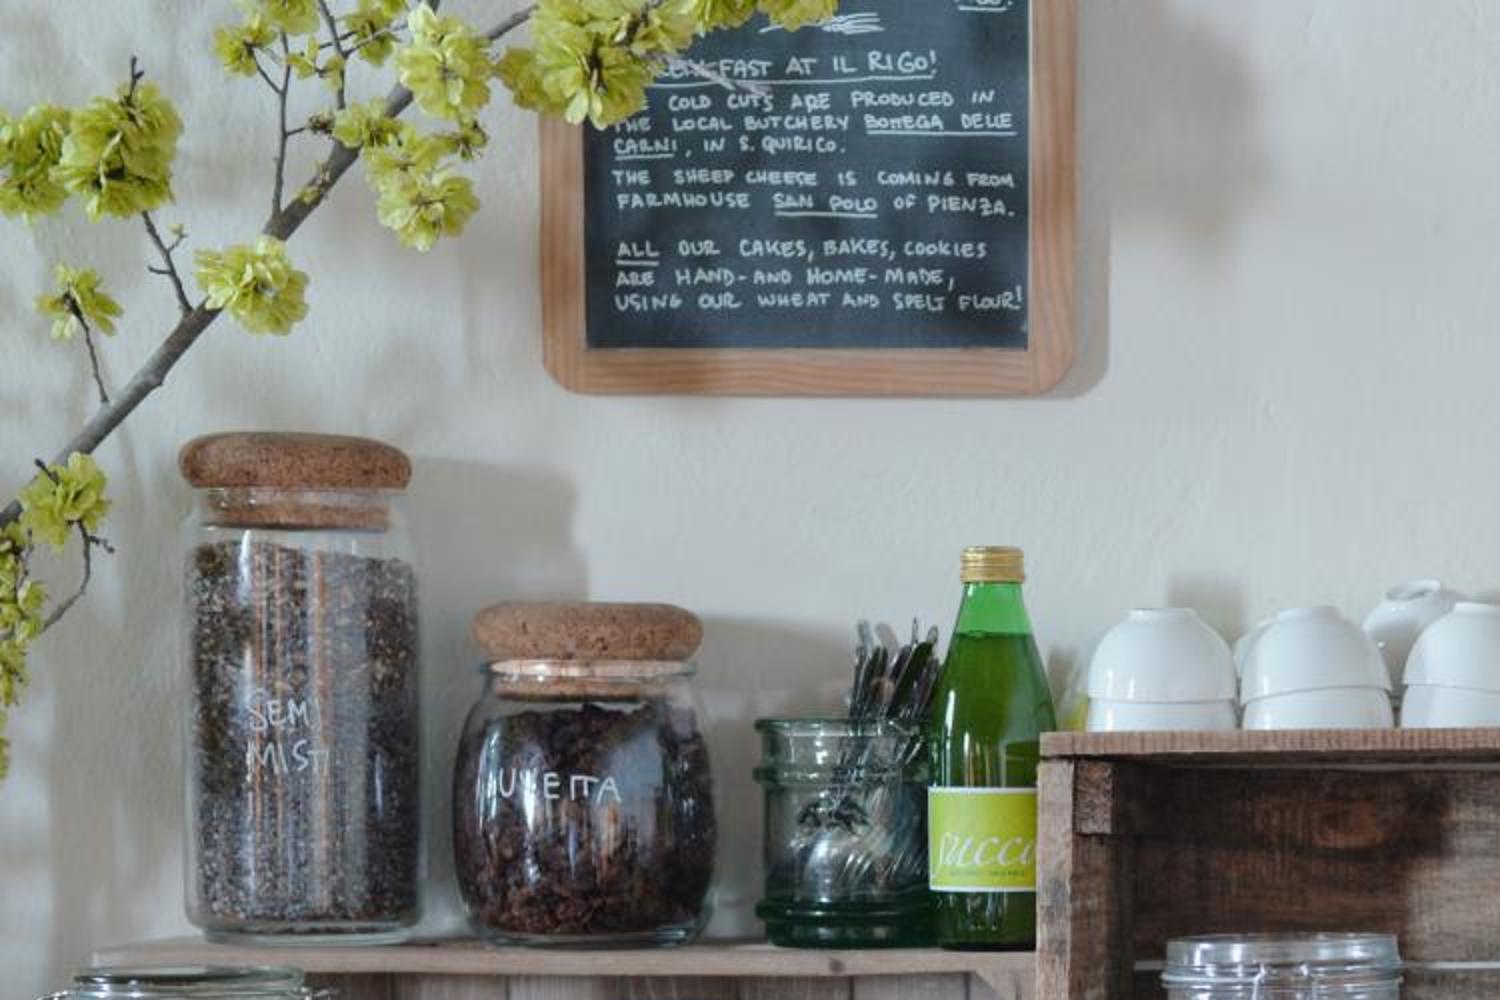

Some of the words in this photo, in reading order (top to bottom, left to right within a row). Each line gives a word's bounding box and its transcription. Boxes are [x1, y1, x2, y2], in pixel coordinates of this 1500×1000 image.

[785, 57, 816, 75] AT
[833, 56, 857, 73] IL
[668, 96, 711, 110] COLD
[727, 95, 773, 111] CUTS
[790, 94, 831, 112] ARE
[851, 91, 954, 108] PRODUCED
[972, 90, 995, 103] IN
[672, 118, 733, 131] LOCAL
[744, 116, 849, 131] BUTCHERY
[864, 114, 944, 130] BOTTEGA
[961, 113, 1012, 129] DELLE
[704, 138, 725, 151] IN
[612, 170, 651, 185] THE
[673, 169, 735, 184] SHEEP
[838, 171, 857, 186] IS
[877, 171, 954, 186] COMING
[967, 173, 1015, 187] FROM
[617, 193, 751, 209] FARMHOUSE
[772, 192, 814, 208] SAN
[829, 195, 878, 212] POLO
[893, 194, 917, 208] OF
[617, 241, 660, 257] ALL
[678, 240, 720, 255] OUR
[739, 239, 813, 262] CAKES,
[823, 239, 896, 260] BAKES,
[616, 271, 655, 287] ARE
[615, 293, 682, 311] USING
[698, 292, 742, 309] OUR
[758, 293, 831, 307] WHEAT
[842, 293, 877, 308] AND
[893, 293, 944, 311] SPELT
[959, 285, 1024, 310] FLOUR!
